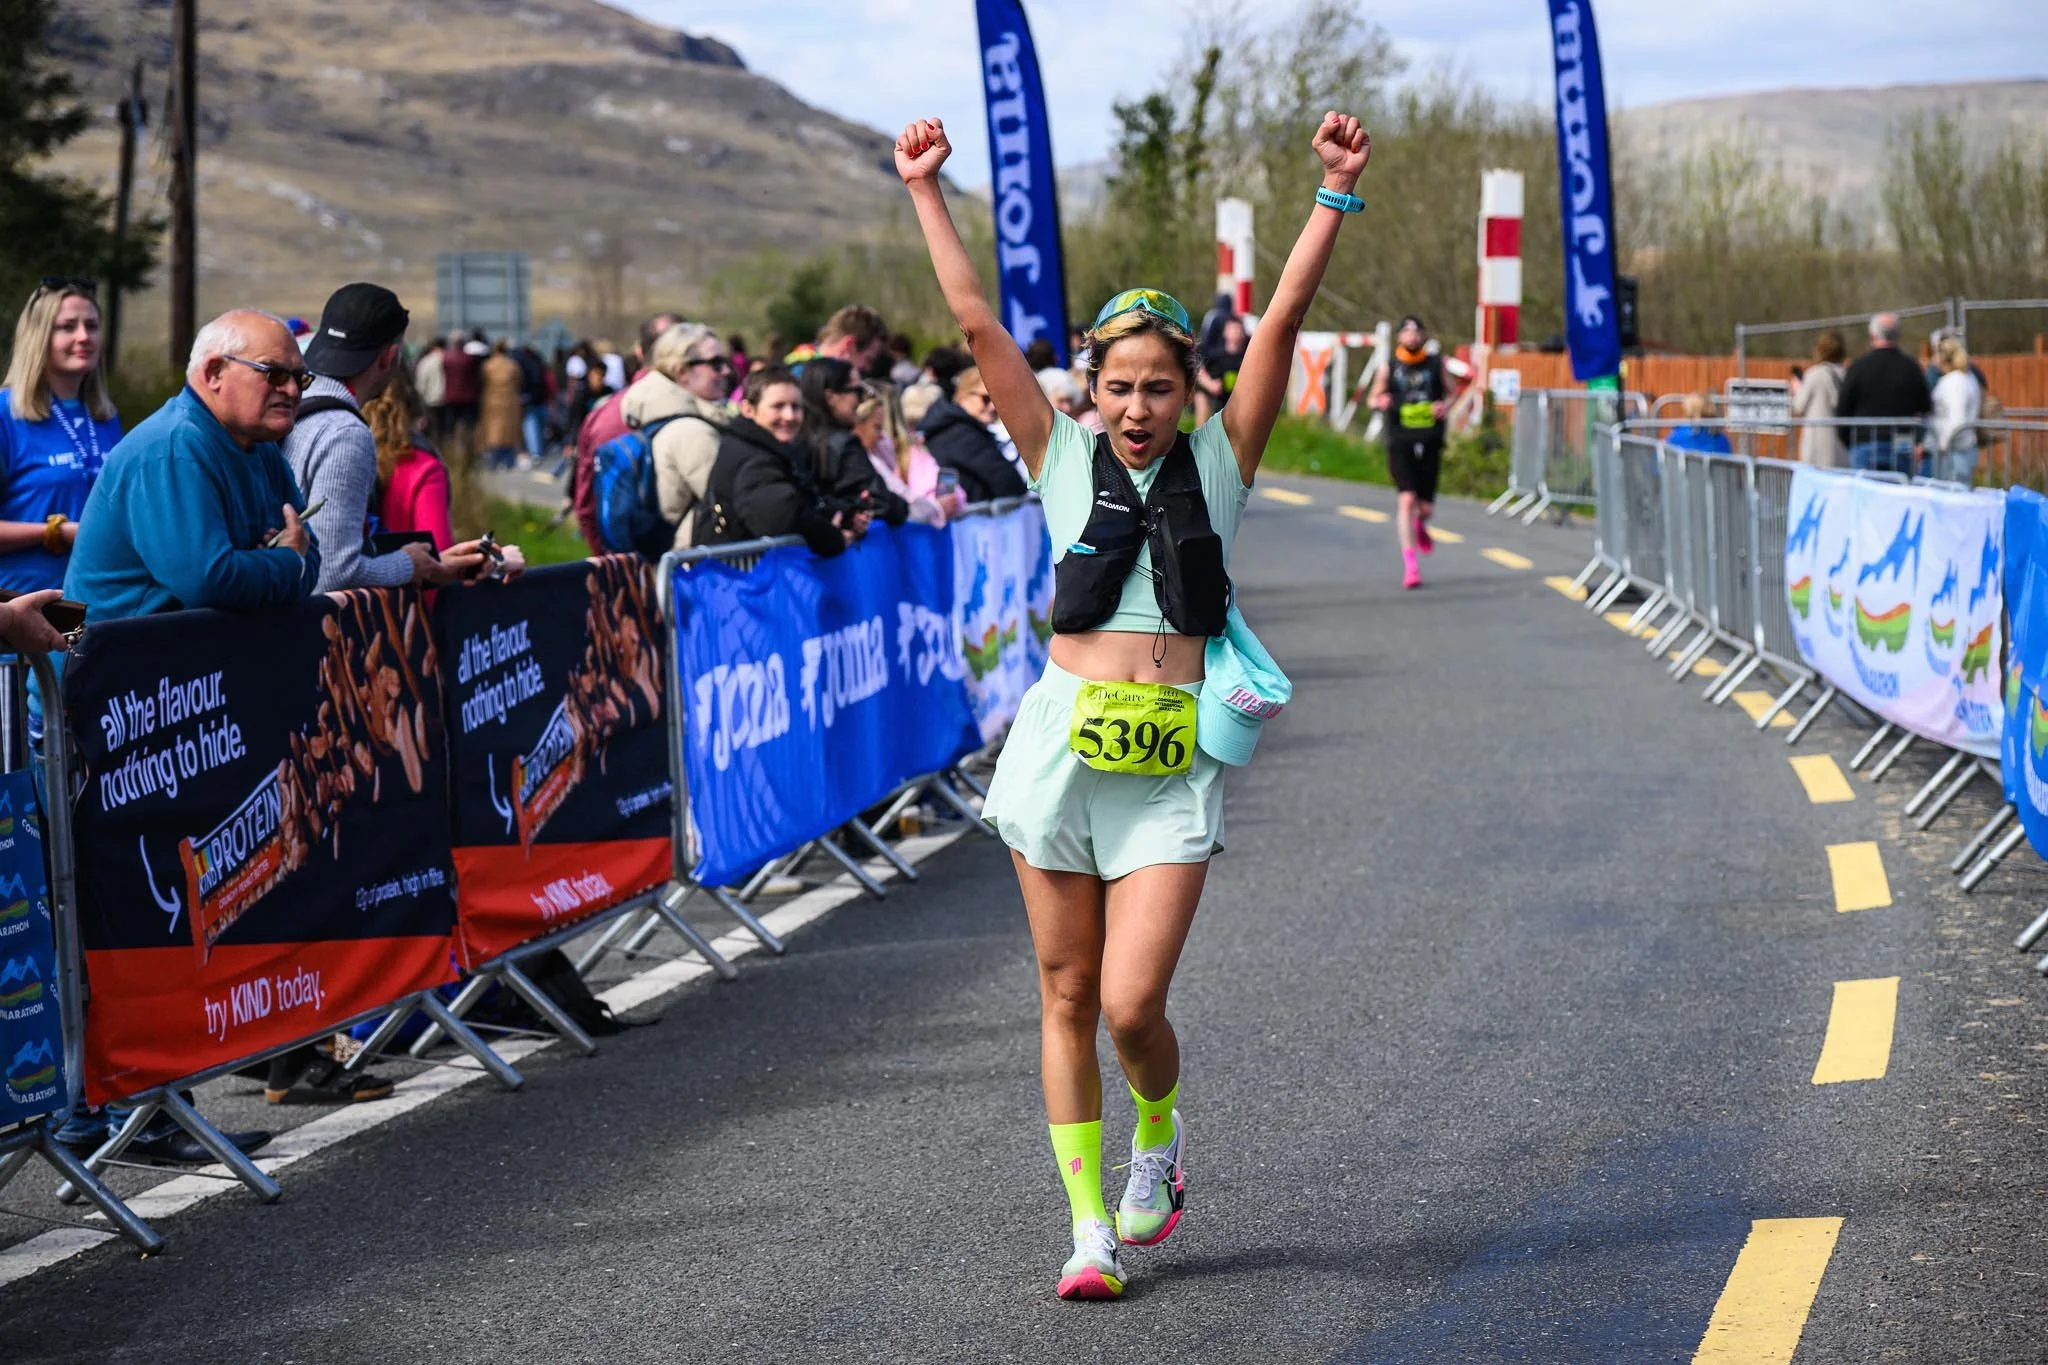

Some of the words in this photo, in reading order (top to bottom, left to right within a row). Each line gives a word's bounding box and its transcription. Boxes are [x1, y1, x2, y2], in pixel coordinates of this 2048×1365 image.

[1096, 499, 1131, 513] SALOMON
[458, 638, 473, 685] all
[471, 632, 492, 676] the
[491, 619, 532, 667] flavour.
[101, 696, 126, 752] all
[125, 689, 156, 741] the
[158, 670, 226, 728] flavour.
[461, 680, 507, 734] nothing
[504, 671, 518, 709] to
[516, 655, 546, 703] hide.
[101, 746, 178, 811] nothing
[175, 734, 198, 779] to
[199, 714, 246, 771] hide.
[1078, 717, 1189, 768] 5396
[211, 781, 282, 881] PROTEIN
[205, 996, 227, 1042] try
[231, 976, 272, 1027] KIND
[276, 965, 326, 1011] today.
